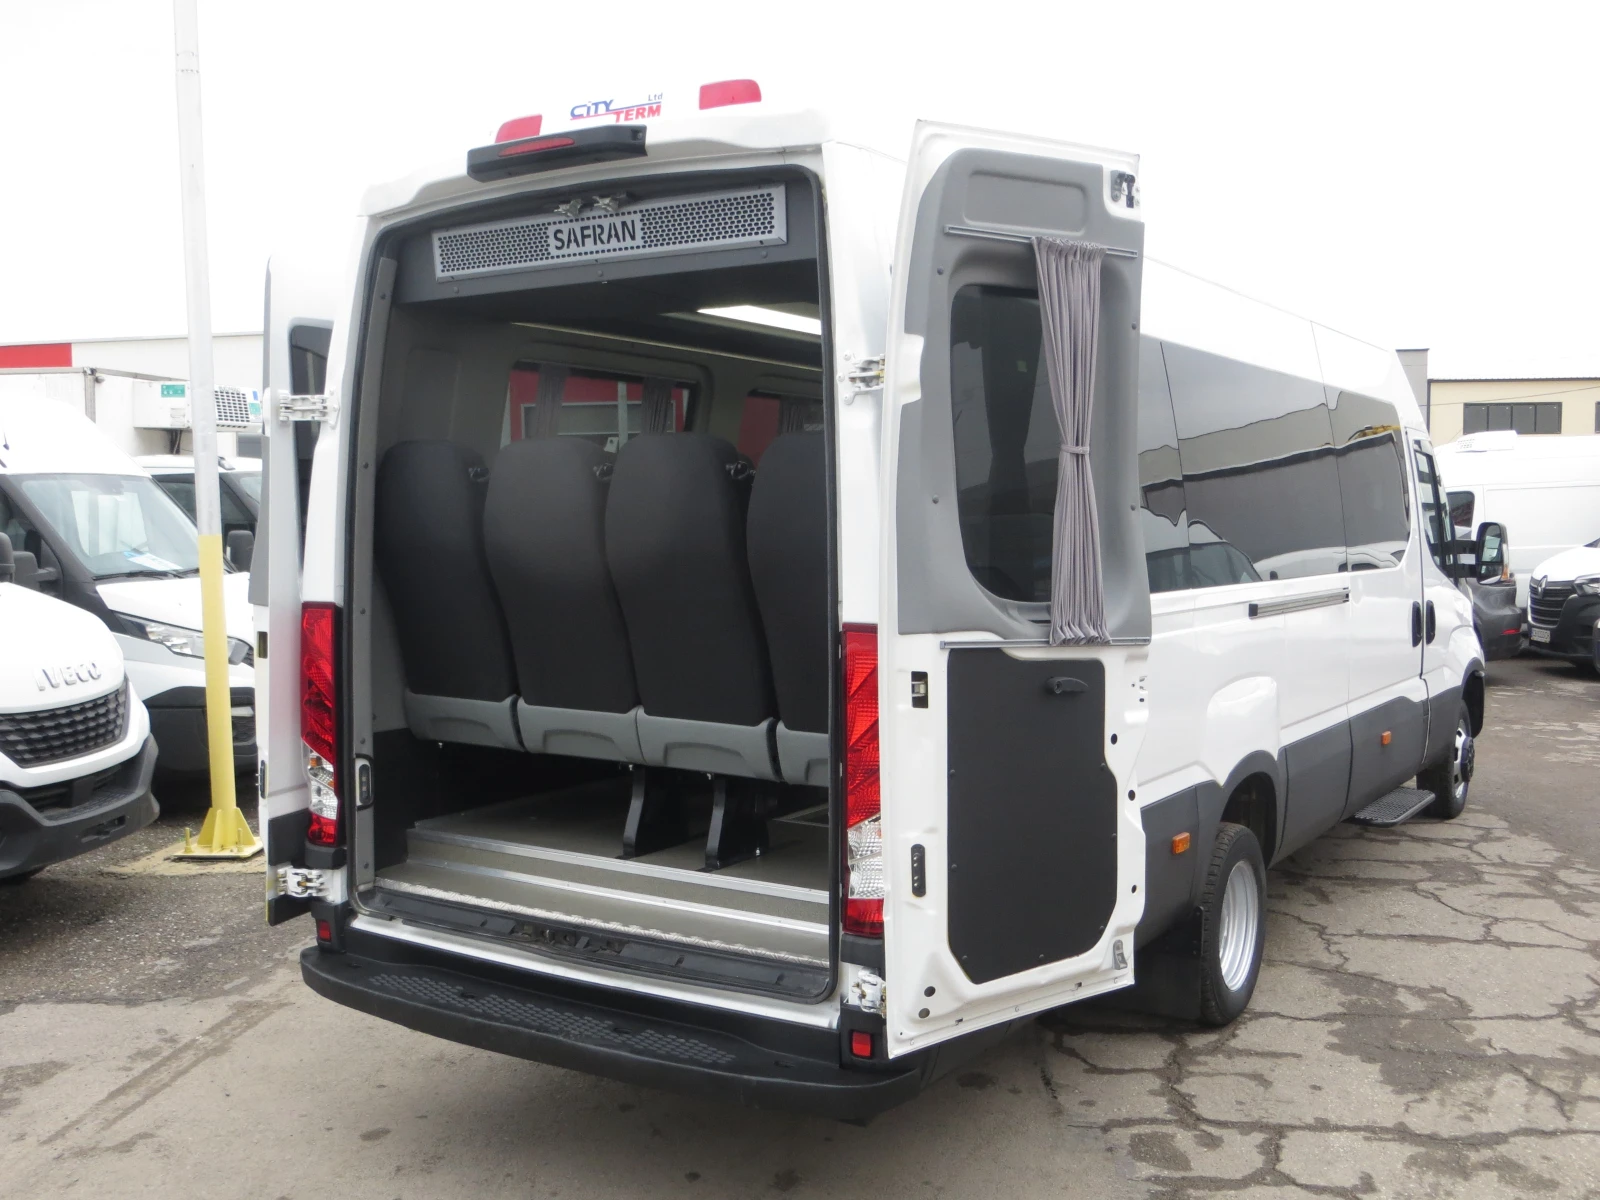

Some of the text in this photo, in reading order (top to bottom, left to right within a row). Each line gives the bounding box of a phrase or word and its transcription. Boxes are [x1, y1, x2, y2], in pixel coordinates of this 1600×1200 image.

[648, 92, 663, 102] Ltd
[612, 104, 662, 124] TERM
[553, 219, 637, 251] SAFRAN
[34, 661, 102, 692] IVECO
